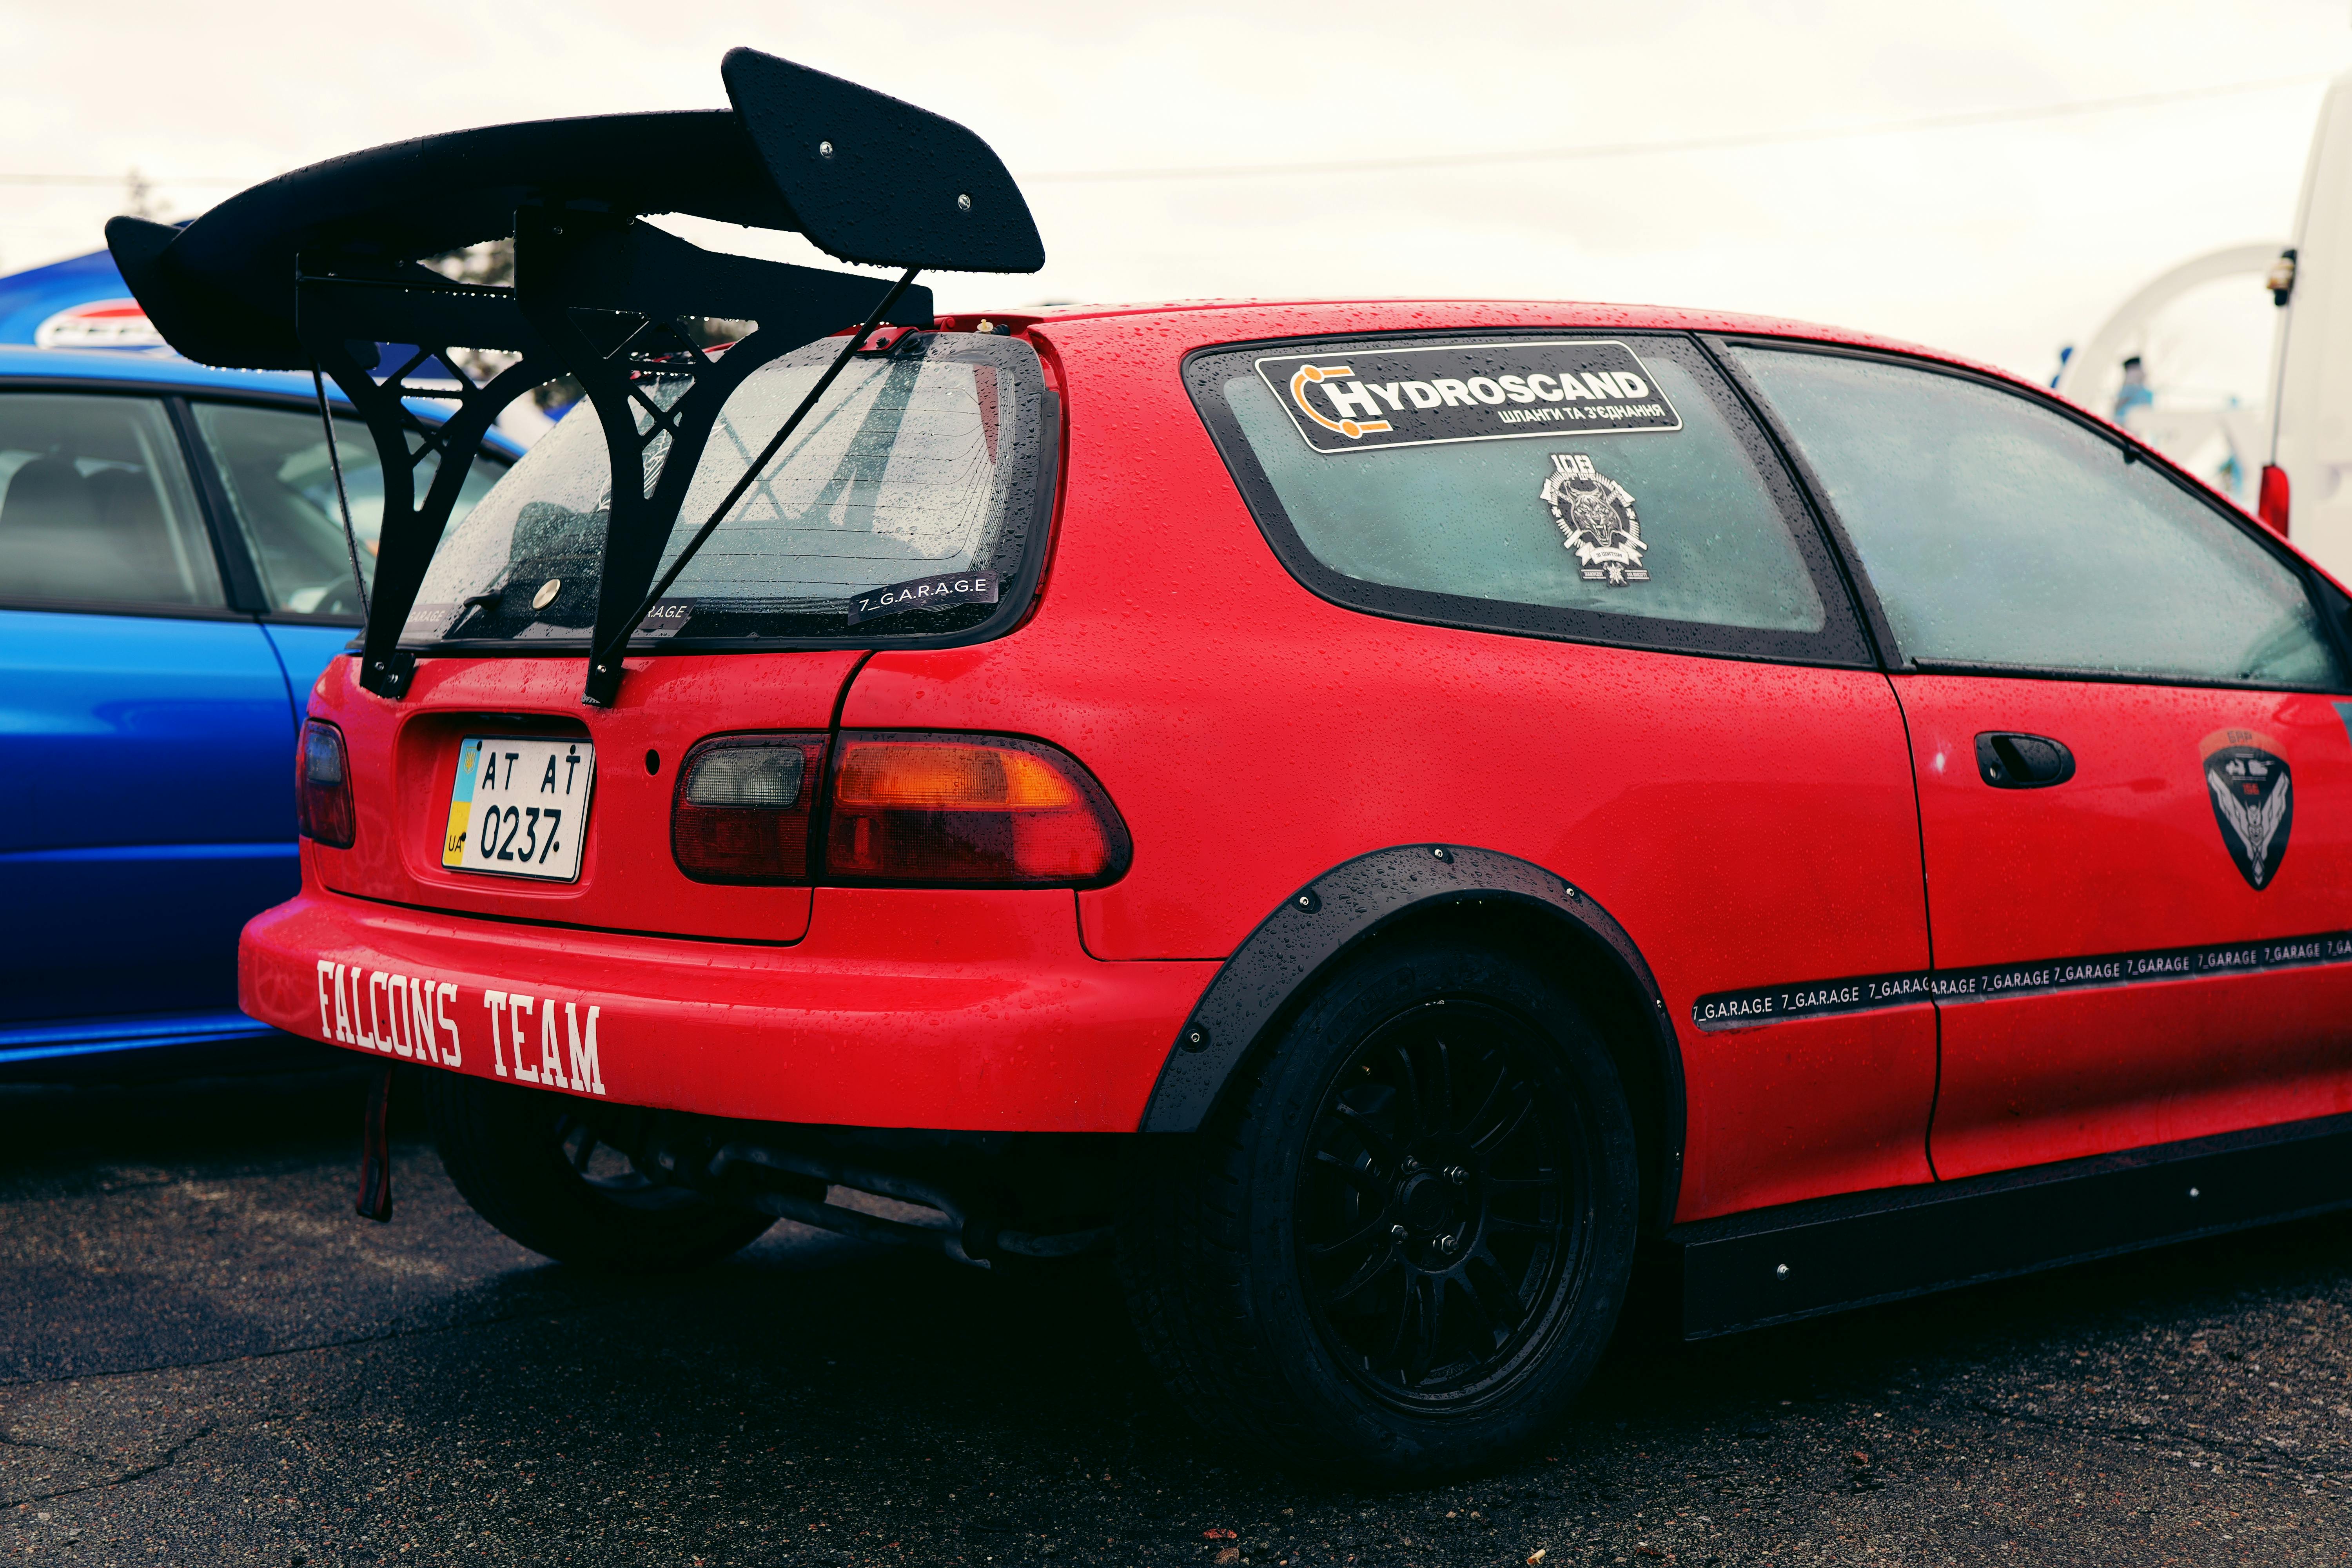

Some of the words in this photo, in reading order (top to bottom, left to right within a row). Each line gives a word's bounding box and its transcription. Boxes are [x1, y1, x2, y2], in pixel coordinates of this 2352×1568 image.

[1320, 371, 1649, 418] HYDROSCAND
[1497, 408, 1564, 423] ШЛАНГИ
[1563, 407, 1586, 419] ТА
[1584, 404, 1666, 420] З'ЄДНАННЯ
[1551, 454, 1595, 474] 108
[482, 752, 519, 790] AT
[541, 755, 581, 794] AT
[448, 835, 461, 853] UA
[481, 805, 561, 864] 0237
[316, 959, 462, 1067] FALCONS
[484, 989, 606, 1096] TEAM
